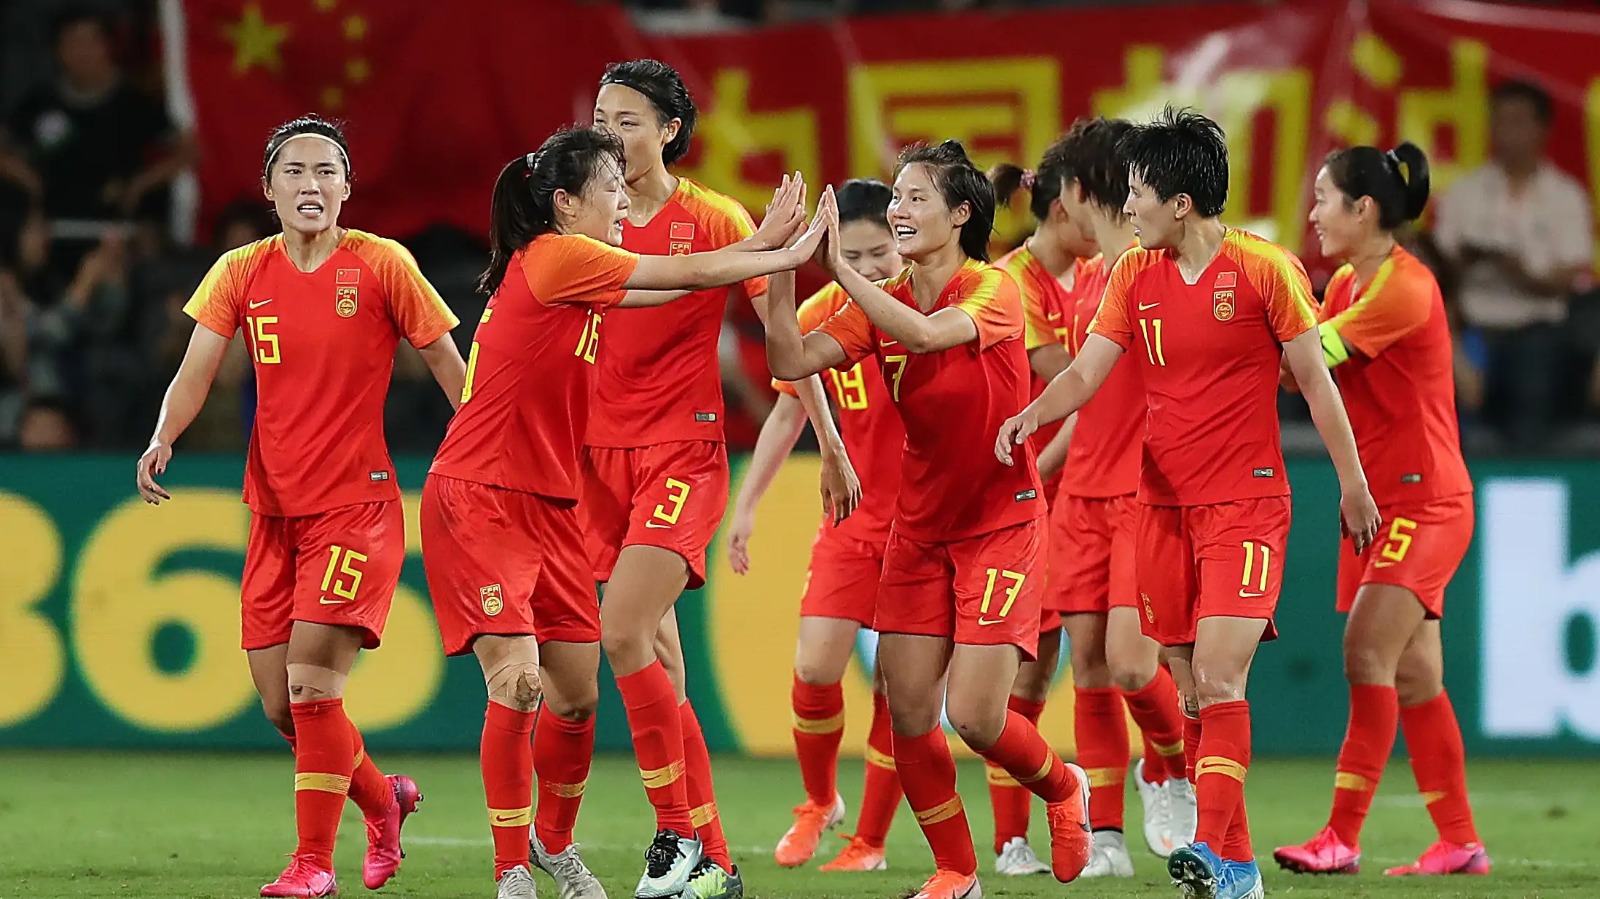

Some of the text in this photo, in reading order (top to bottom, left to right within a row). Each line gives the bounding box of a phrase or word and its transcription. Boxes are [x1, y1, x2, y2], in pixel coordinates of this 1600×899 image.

[246, 316, 281, 364] 15
[1139, 318, 1166, 366] 11
[828, 361, 868, 410] 19
[881, 354, 908, 402] 7
[653, 477, 691, 525] 3
[1381, 516, 1418, 562] 5
[320, 544, 368, 601] 15
[1241, 541, 1270, 592] 11
[980, 567, 1026, 618] 17
